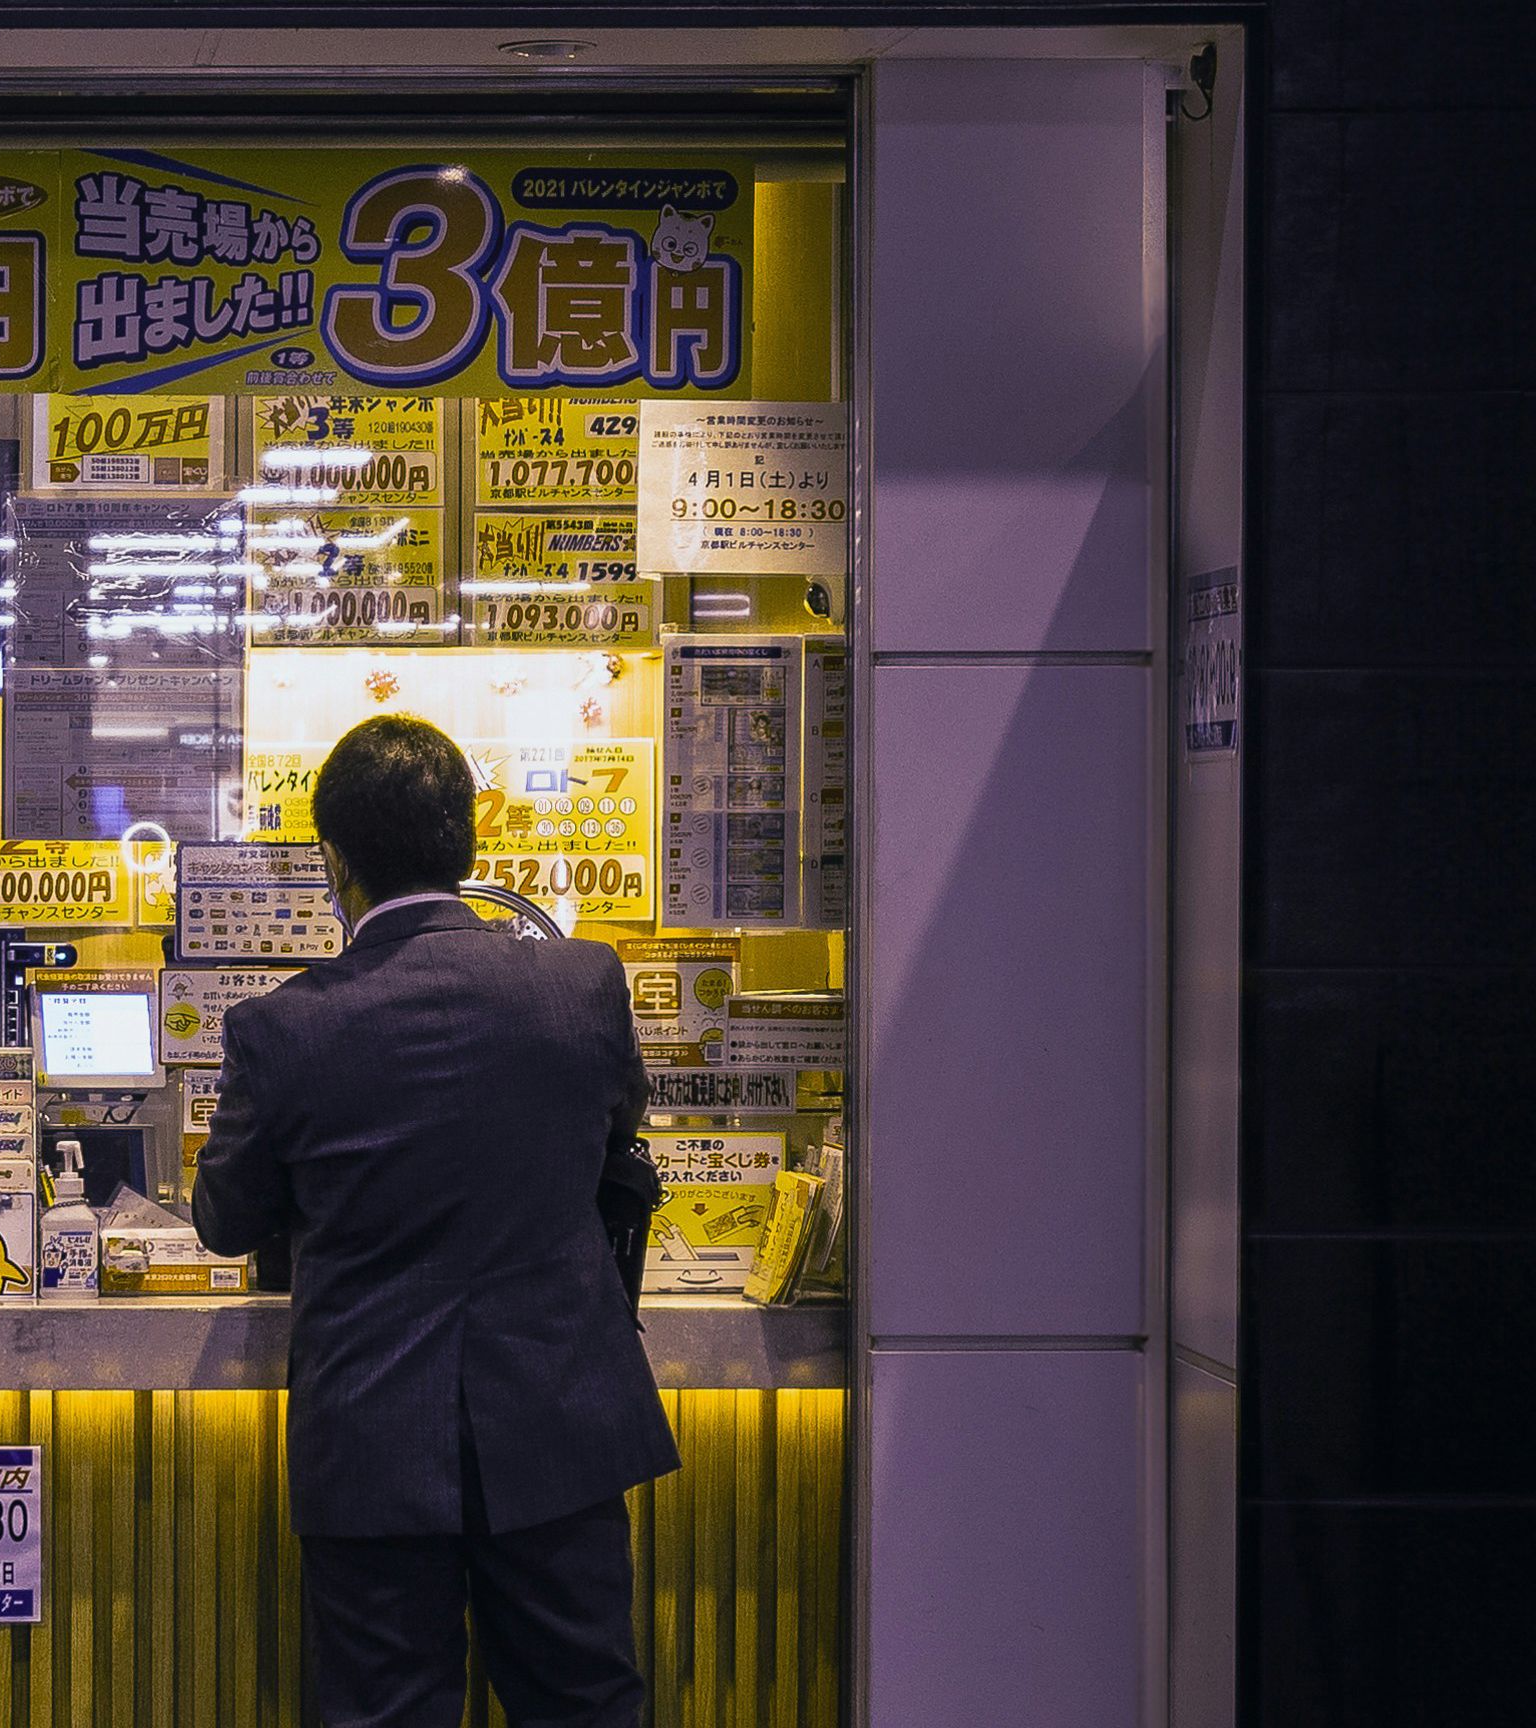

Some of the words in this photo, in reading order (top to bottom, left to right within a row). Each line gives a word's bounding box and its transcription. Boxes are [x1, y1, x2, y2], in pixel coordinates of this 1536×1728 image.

[523, 178, 566, 199] 2021
[571, 178, 728, 201] バレンタインジャンボで
[74, 172, 321, 266] 当売場から
[322, 164, 740, 388] 3億円
[74, 271, 314, 365] 出ました!!
[54, 403, 210, 457] 100万円
[590, 416, 639, 435] 429
[755, 455, 764, 465] 記
[701, 541, 815, 550] 京都駅ビルチャンスセンター
[675, 1139, 725, 1151] ご不要の
